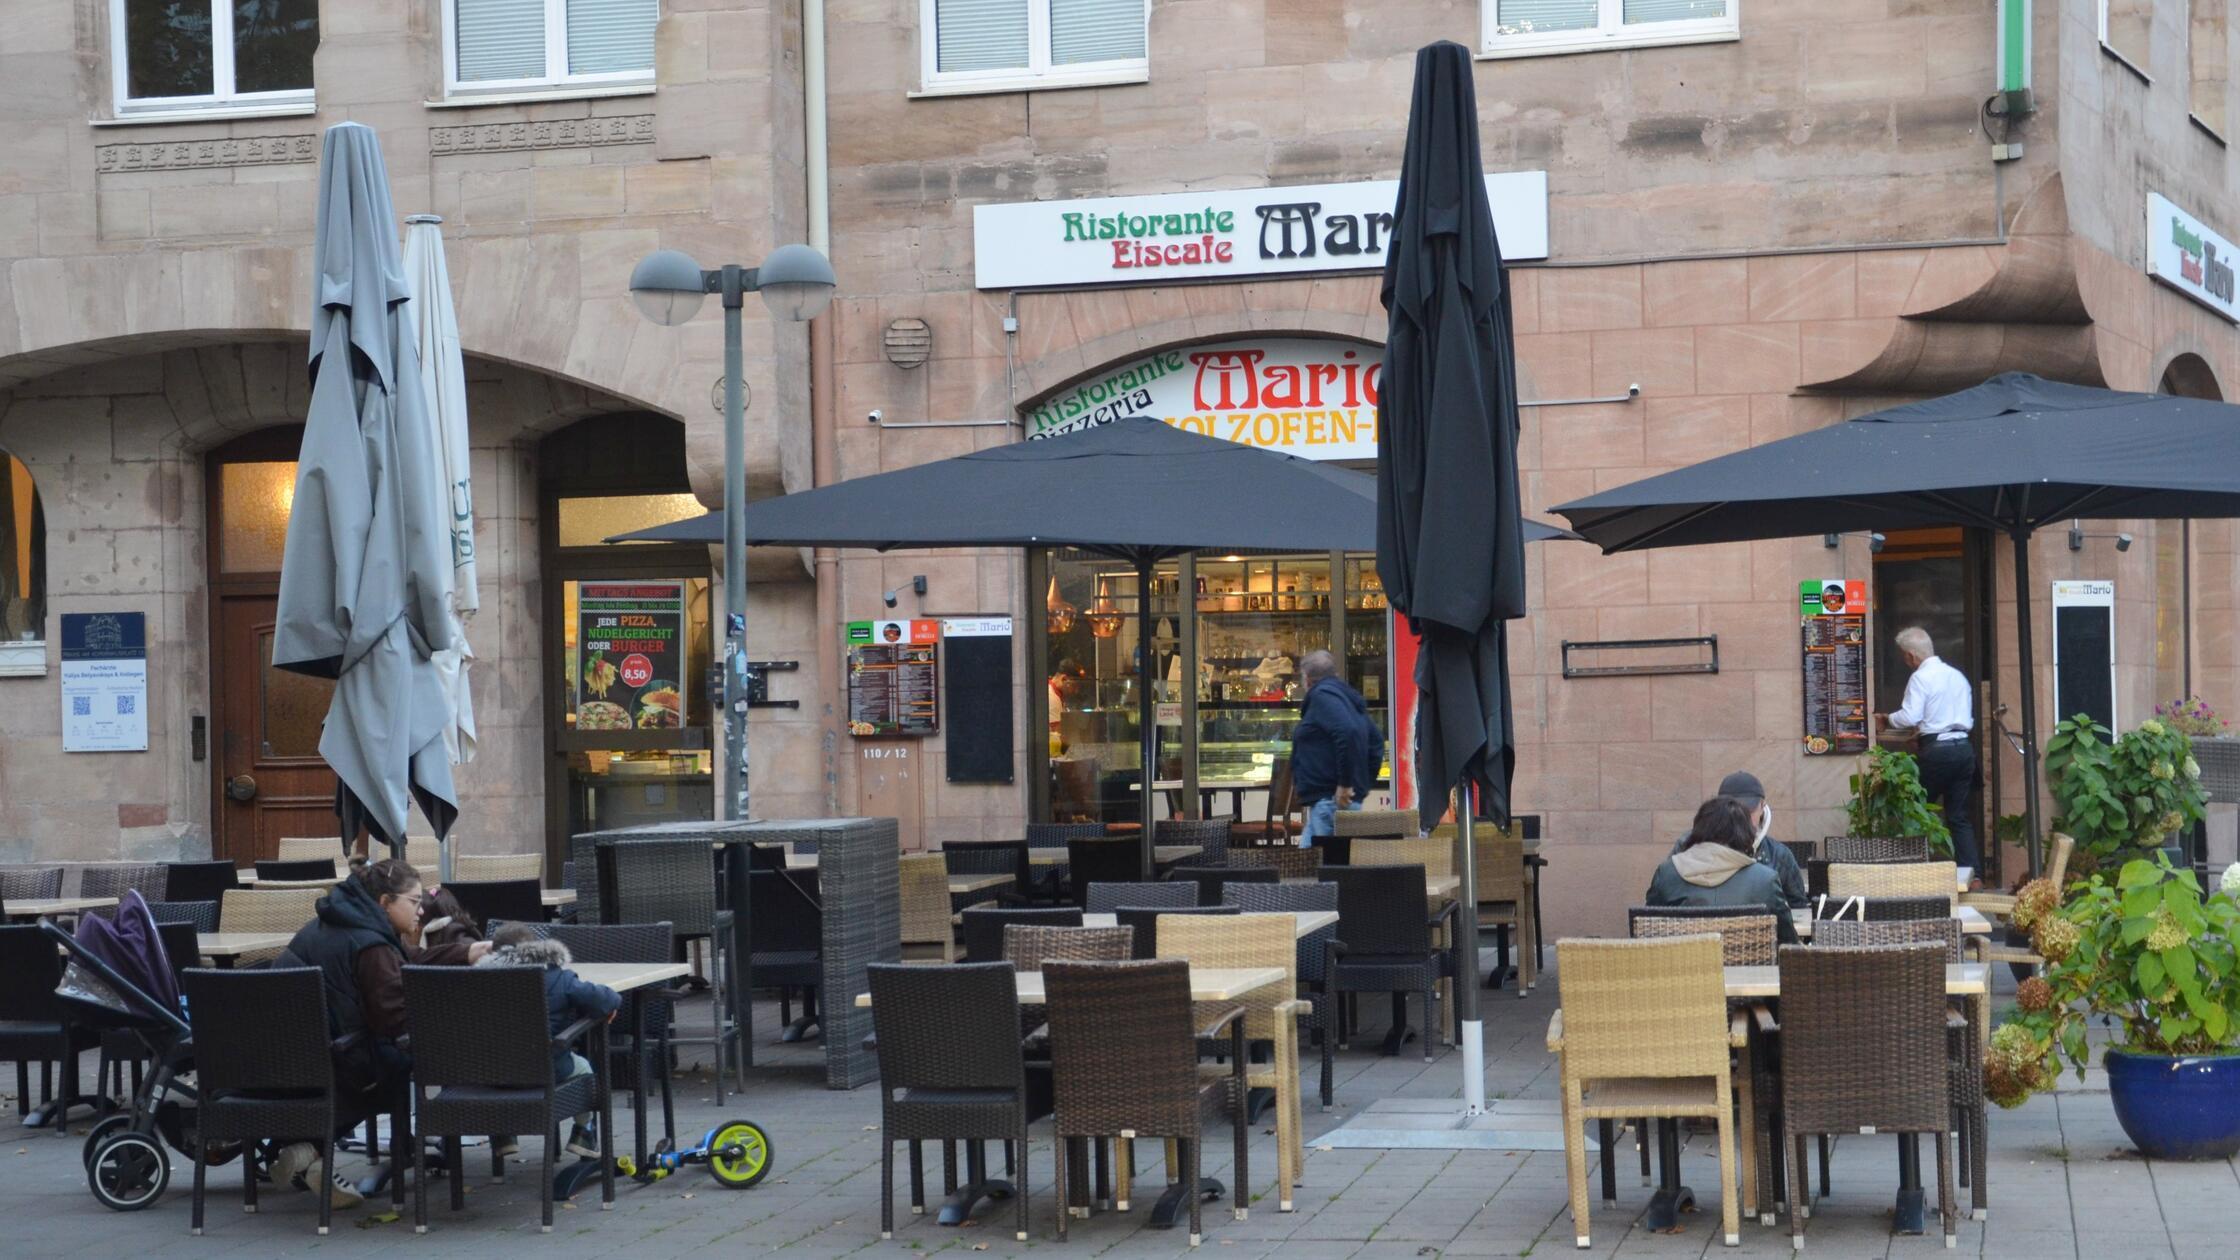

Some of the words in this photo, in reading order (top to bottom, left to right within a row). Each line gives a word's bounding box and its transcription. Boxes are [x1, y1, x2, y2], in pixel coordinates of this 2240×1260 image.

[1062, 207, 1234, 241] Ristorante
[1255, 202, 1393, 259] Mar
[1112, 235, 1233, 268] Eiscafe
[1030, 351, 1184, 431] Ristorante
[2083, 584, 2111, 595] Mario
[596, 617, 618, 628] JEDE
[621, 615, 657, 627] PIZZA,
[980, 622, 1010, 632] Mario
[588, 628, 673, 639] NUDELGERICHT
[587, 641, 611, 651] ODER
[611, 640, 664, 653] BURGER
